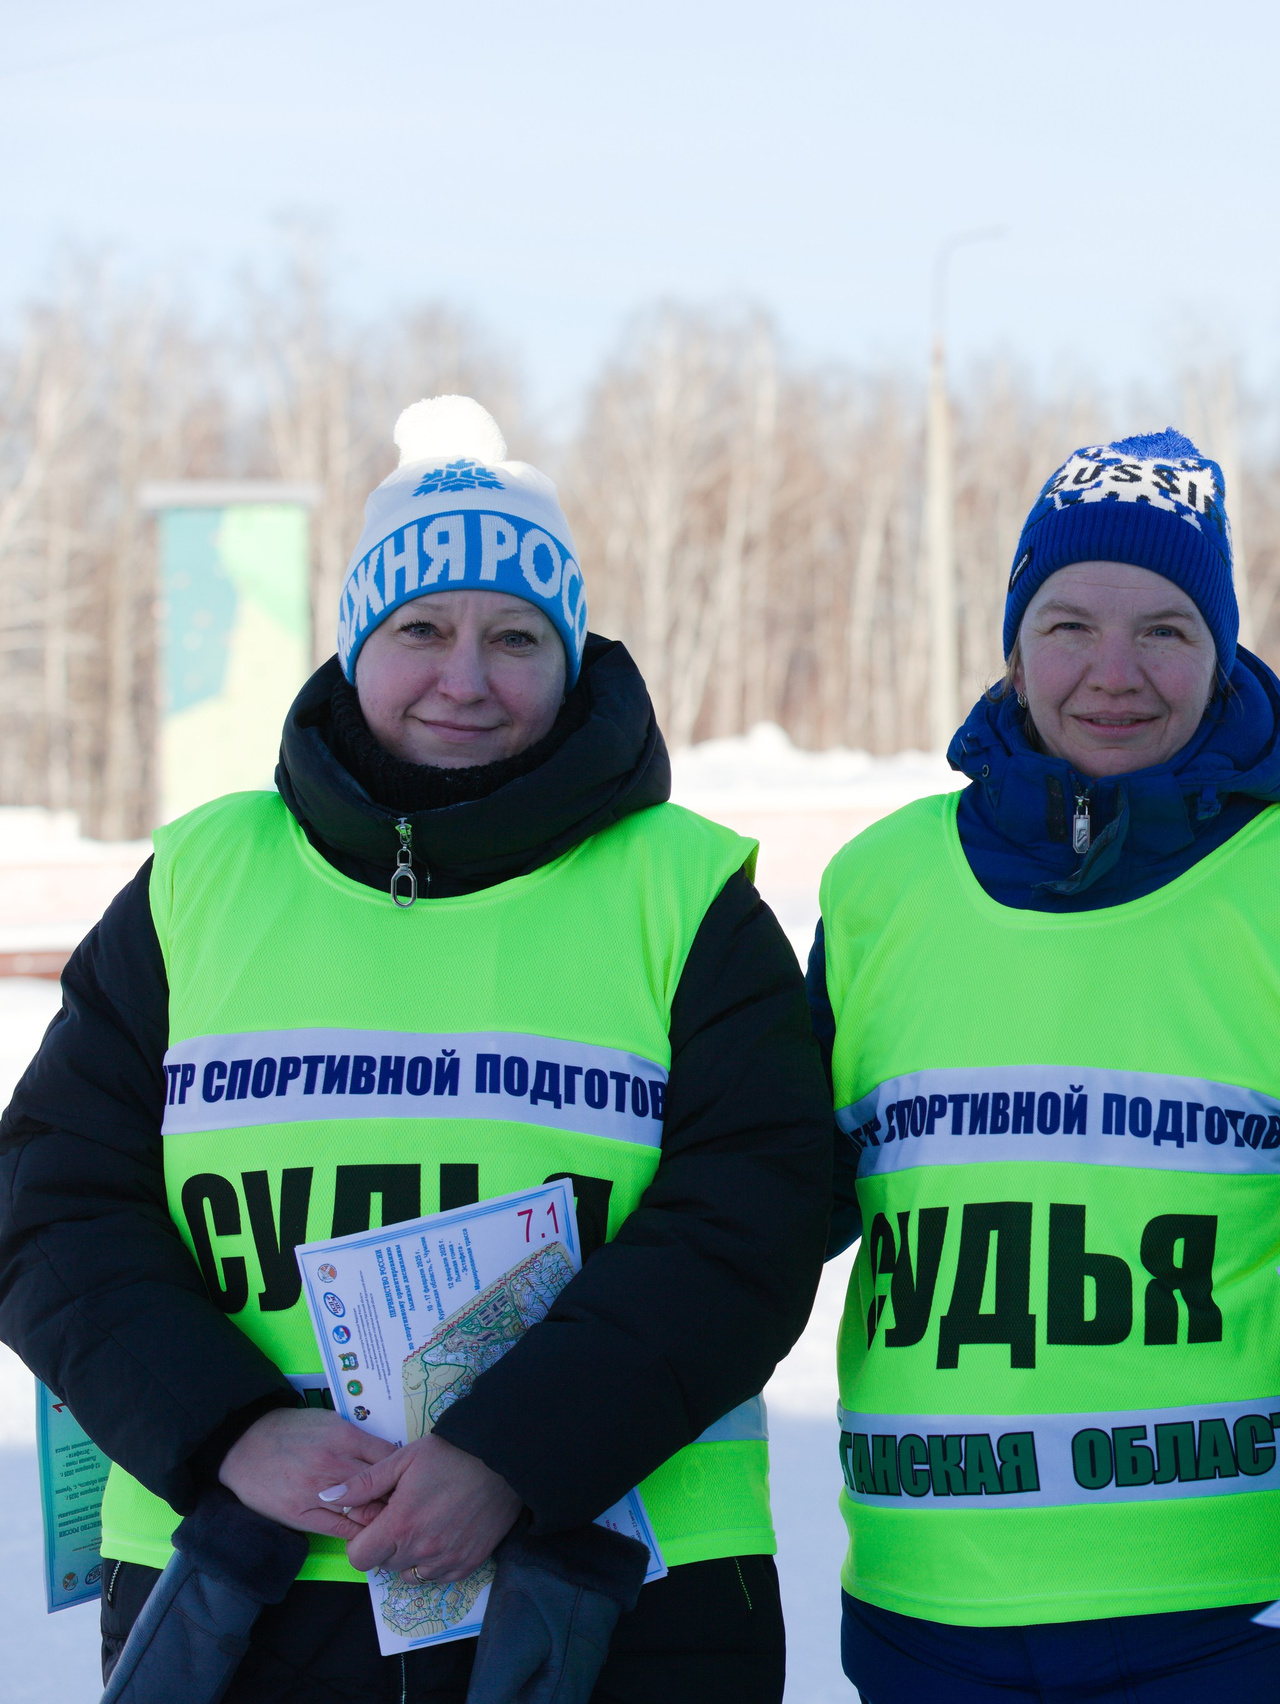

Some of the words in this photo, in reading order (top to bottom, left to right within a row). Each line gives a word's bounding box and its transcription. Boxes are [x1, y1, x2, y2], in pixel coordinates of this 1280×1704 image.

[164, 1063, 196, 1106] ТР
[202, 1049, 460, 1104] СПОРТИВНОЙ
[475, 1053, 667, 1122] ПОДГОТОВ
[884, 1084, 1088, 1143] СПОРТИВНОЙ
[517, 1202, 559, 1242] 7.1
[375, 1249, 387, 1275] РОССИИ
[415, 1255, 423, 1268] 2025
[439, 1244, 447, 1257] 2025
[443, 1257, 453, 1282] февраля
[386, 1247, 402, 1299] ориентированию
[419, 1268, 430, 1293] февраля
[867, 1201, 1223, 1370] СУДЬЯ
[382, 1276, 397, 1318] ПЕРВЕНСТВО
[433, 1289, 445, 1320] Курганская
[398, 1301, 412, 1341] спортивному
